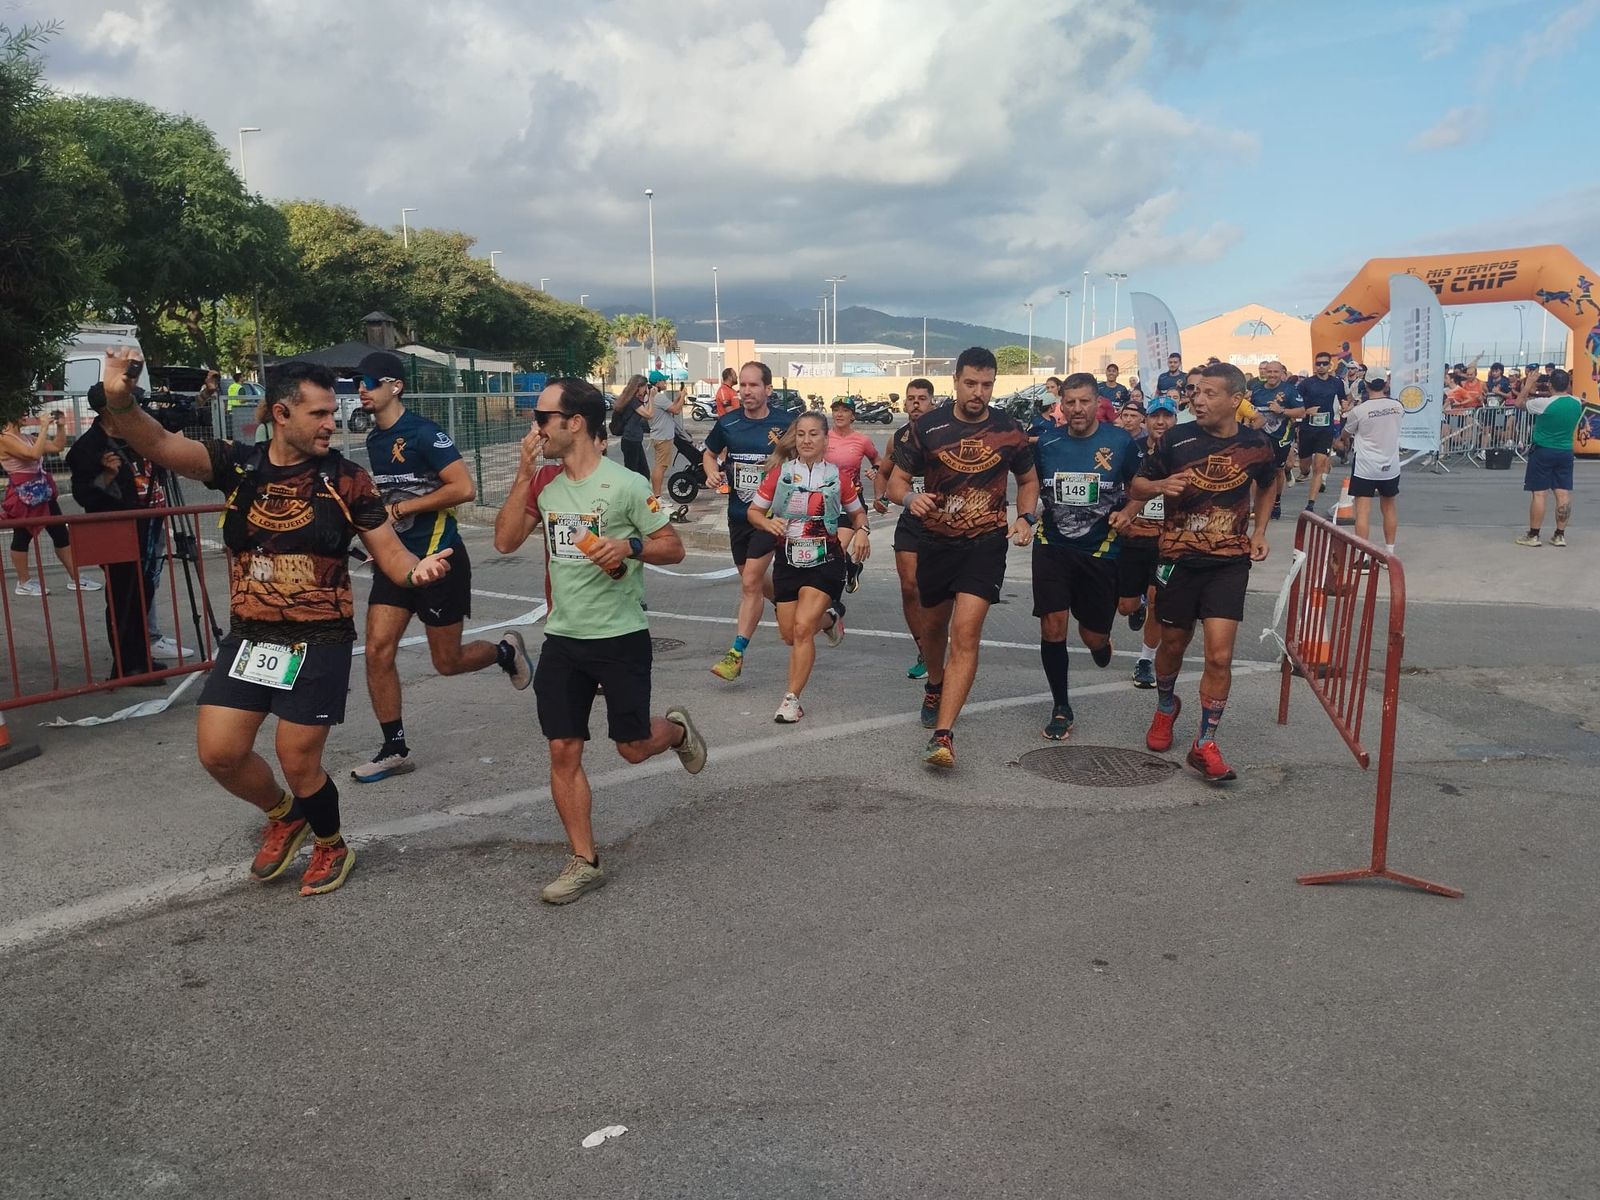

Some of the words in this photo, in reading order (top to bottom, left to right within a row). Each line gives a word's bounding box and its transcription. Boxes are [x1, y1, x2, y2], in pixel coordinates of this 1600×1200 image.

[1426, 268, 1453, 279] MIS
[1456, 260, 1520, 275] TIEMPOS
[1427, 278, 1445, 295] N
[1450, 270, 1519, 293] CHIP
[972, 456, 999, 472] FUERTES
[741, 475, 759, 484] 102
[1065, 485, 1086, 496] 148
[1150, 502, 1163, 512] 29
[259, 518, 276, 529] LOS
[798, 549, 811, 559] 36
[264, 642, 299, 655] FORTALEA
[256, 653, 278, 671] 30
